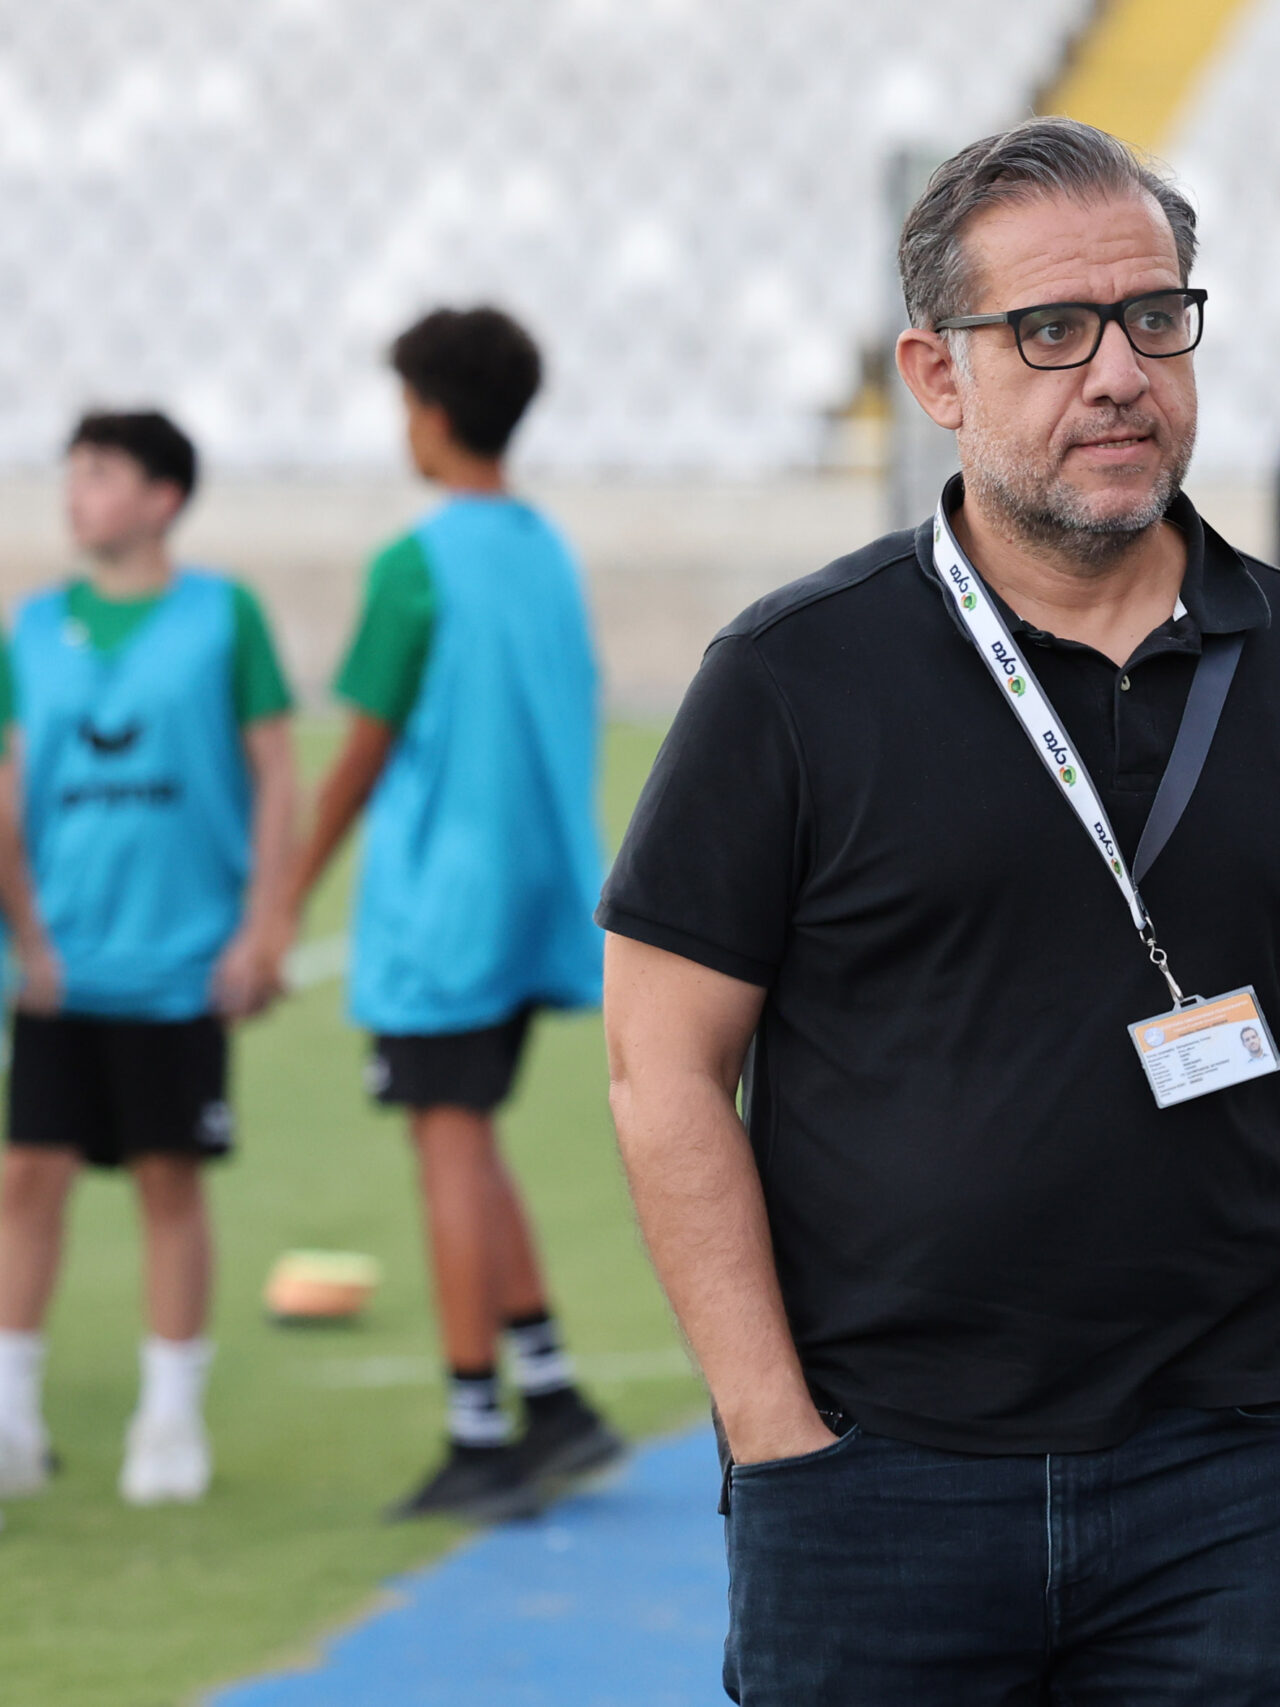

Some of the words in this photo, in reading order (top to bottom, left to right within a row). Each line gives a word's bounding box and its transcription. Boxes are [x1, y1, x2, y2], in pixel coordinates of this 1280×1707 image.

[949, 564, 970, 594] cyta
[991, 640, 1018, 676] cyta
[1042, 730, 1068, 765] cyta
[1094, 822, 1115, 857] cyta
